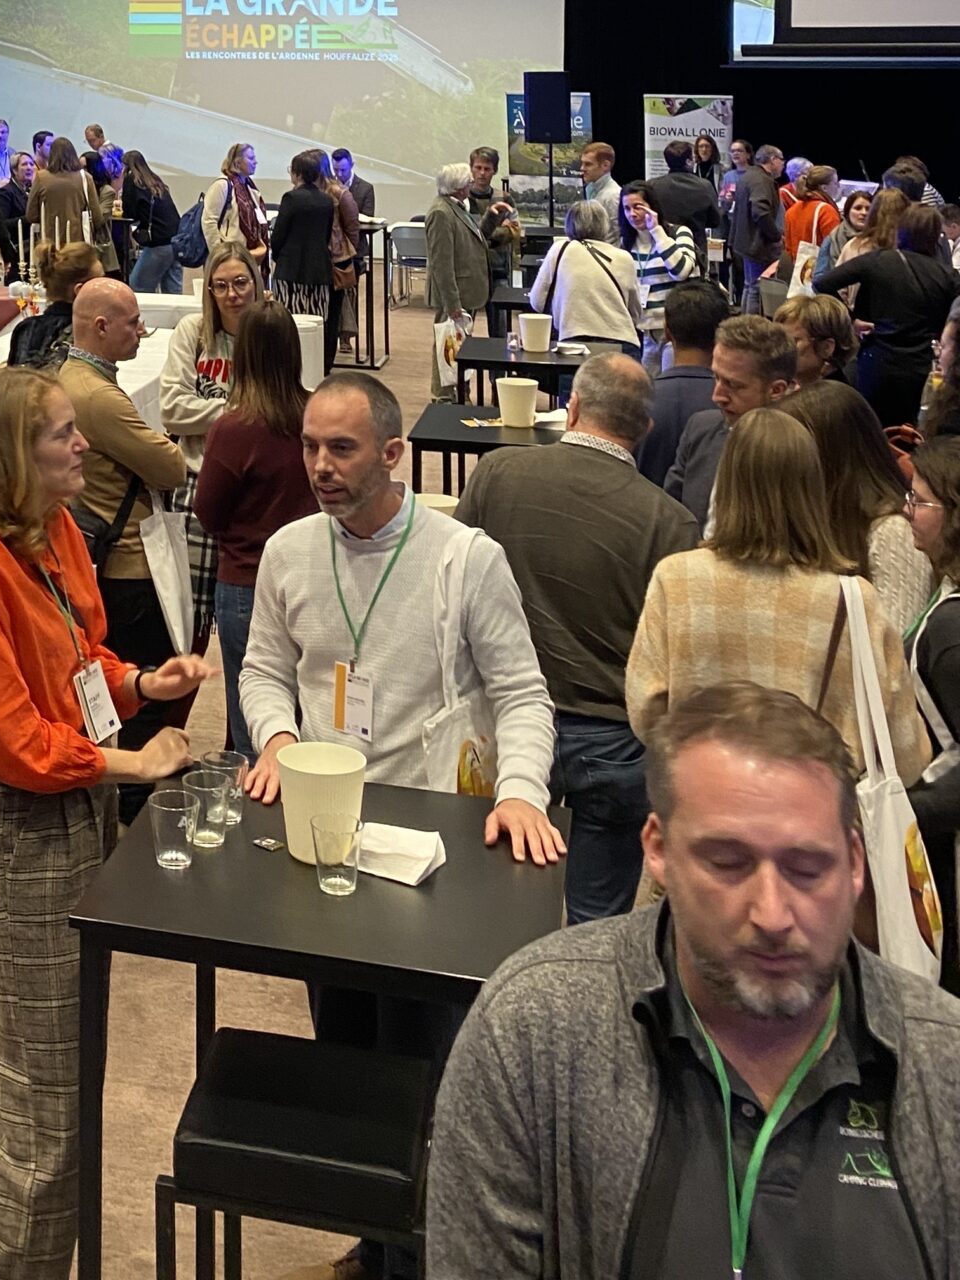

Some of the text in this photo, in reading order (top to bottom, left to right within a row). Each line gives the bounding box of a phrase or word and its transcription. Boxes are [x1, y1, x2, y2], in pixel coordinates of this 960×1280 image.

[185, 51, 201, 59] LES
[202, 51, 258, 60] RENCONTRES
[258, 52, 271, 60] DE
[649, 126, 726, 138] BIOWALLONIE
